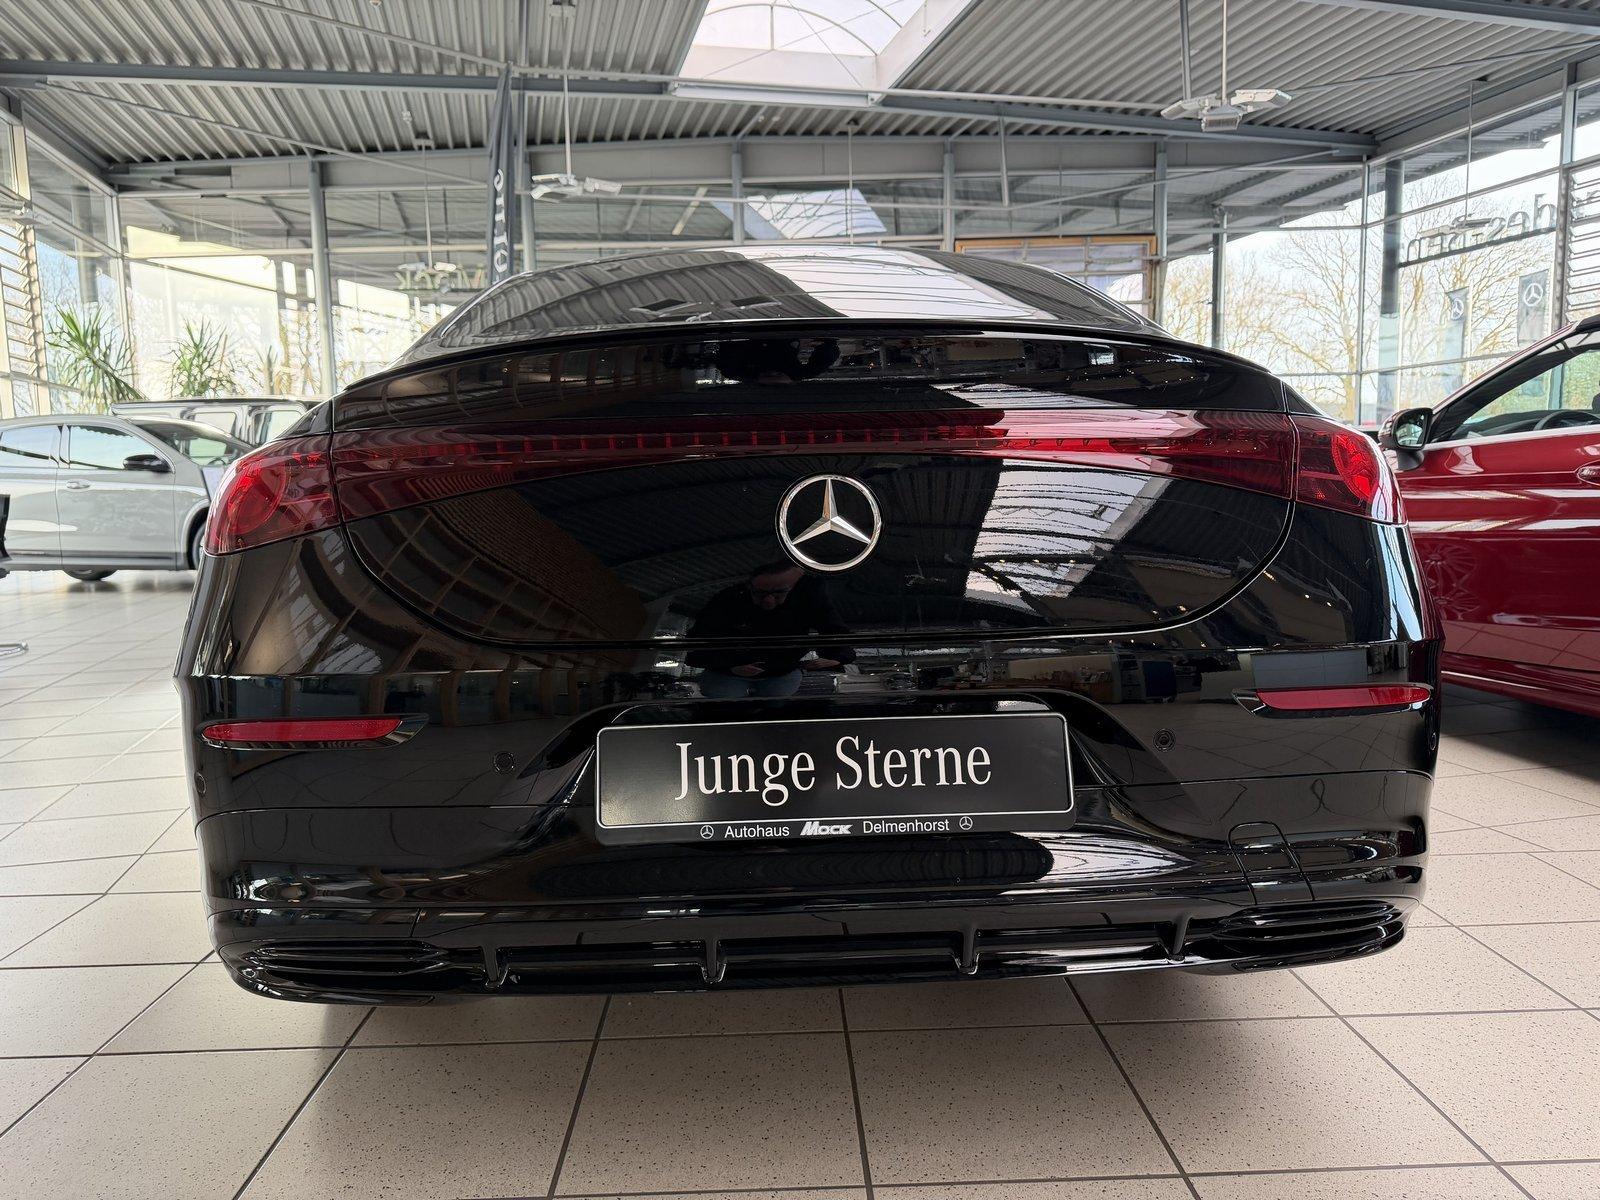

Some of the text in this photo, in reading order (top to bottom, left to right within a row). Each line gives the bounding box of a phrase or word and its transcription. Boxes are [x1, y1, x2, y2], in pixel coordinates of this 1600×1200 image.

[674, 735, 992, 807] Junge Sterne
[724, 824, 791, 840] Autohaus
[862, 818, 951, 834] Delmenhorst
